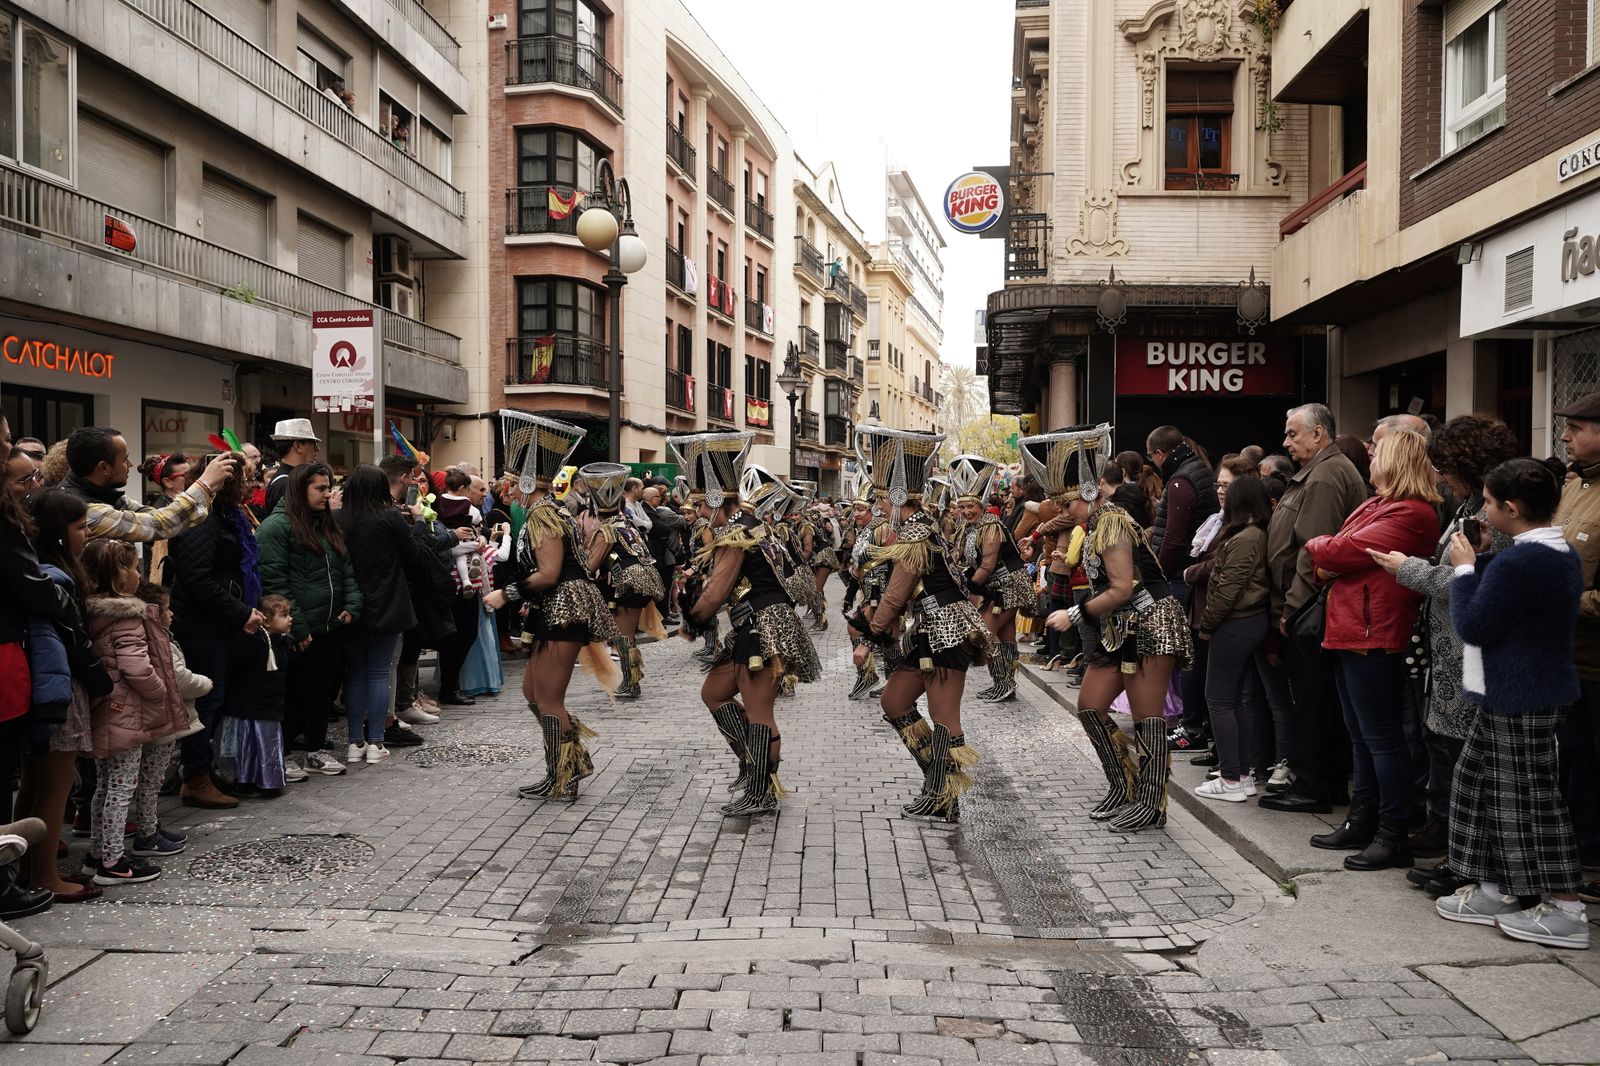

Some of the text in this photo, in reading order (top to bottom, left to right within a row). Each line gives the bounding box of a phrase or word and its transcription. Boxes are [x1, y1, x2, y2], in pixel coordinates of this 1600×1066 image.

[950, 185, 998, 203] BURGER
[950, 195, 998, 219] KING
[2, 335, 115, 379] CATCHALOT
[1147, 342, 1266, 365] BURGER
[1168, 368, 1244, 392] KING
